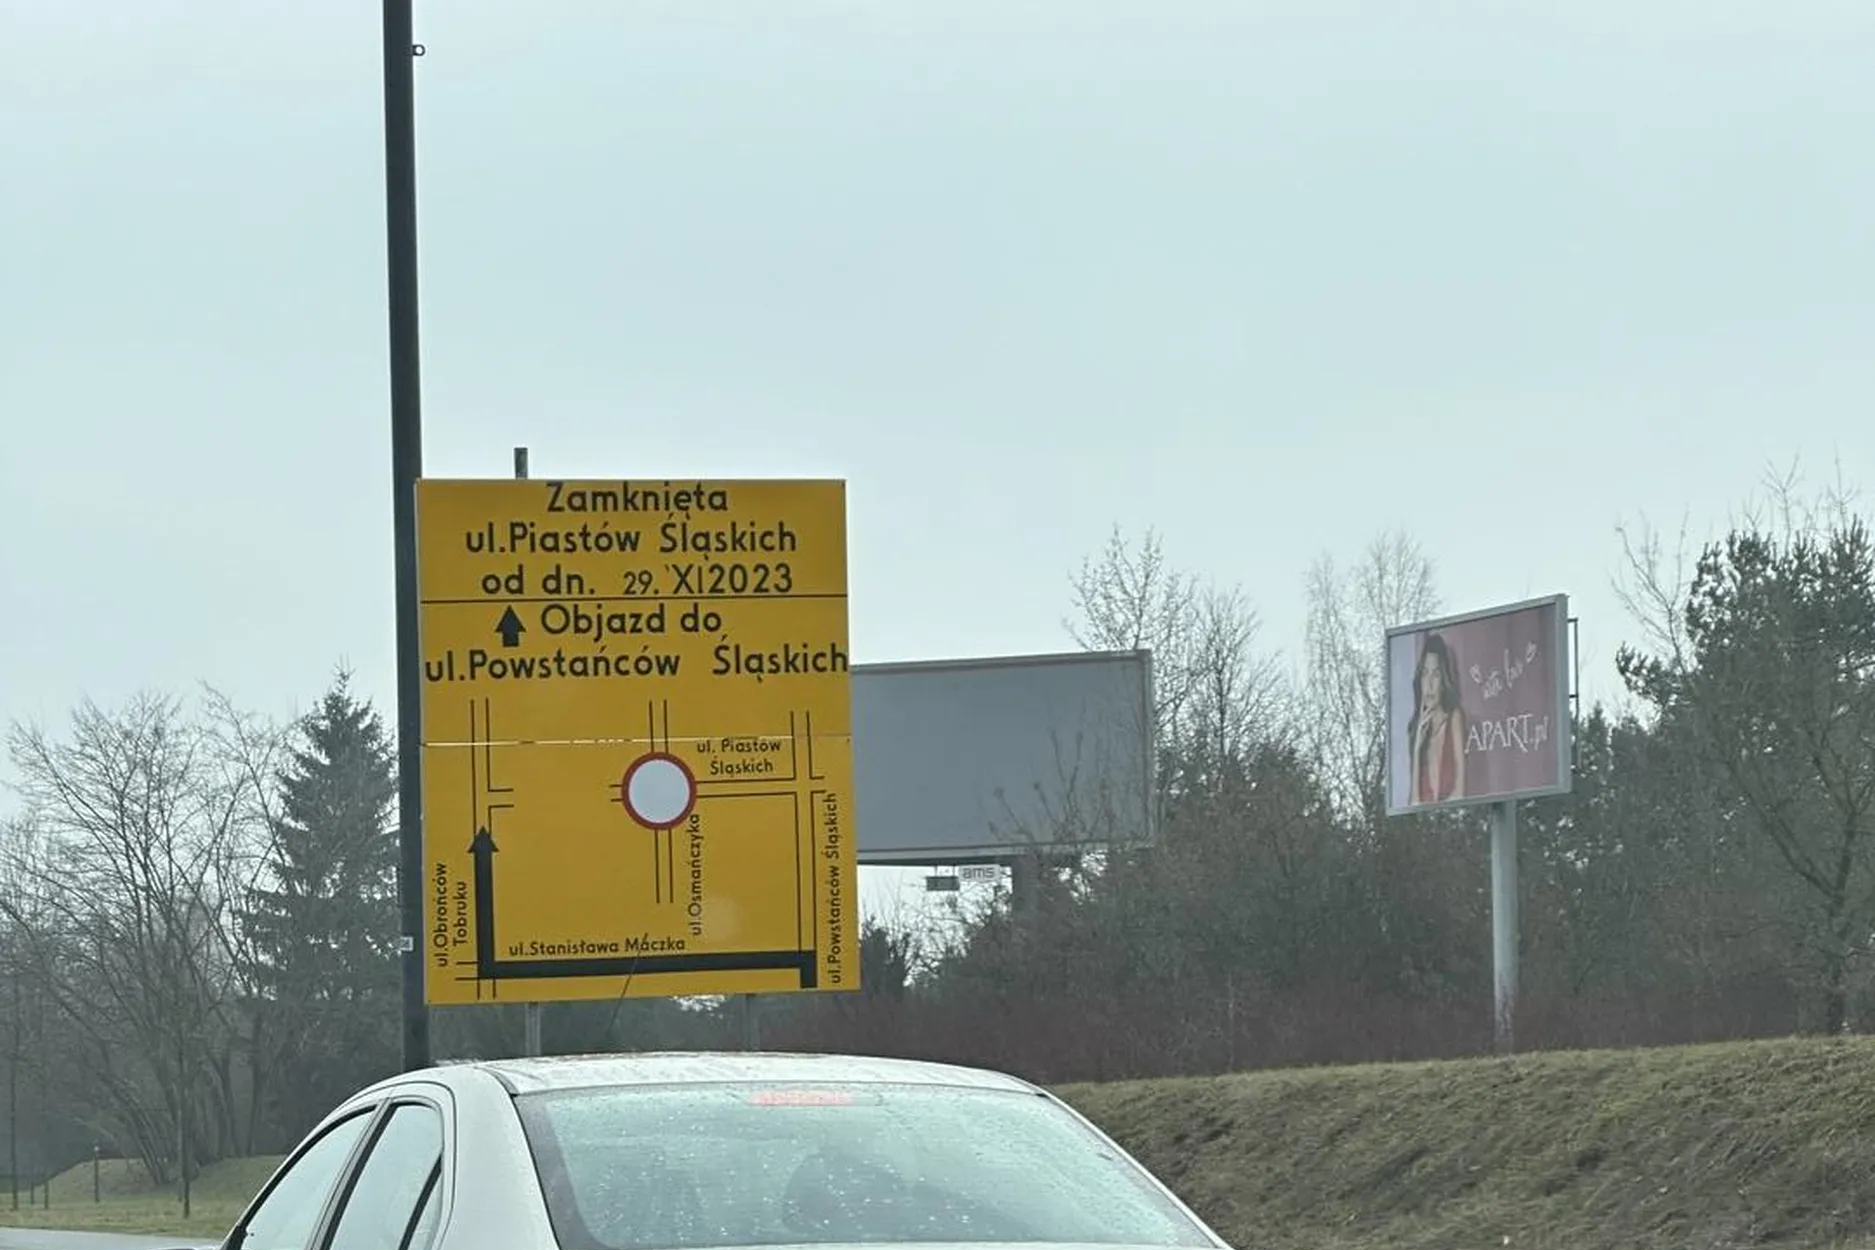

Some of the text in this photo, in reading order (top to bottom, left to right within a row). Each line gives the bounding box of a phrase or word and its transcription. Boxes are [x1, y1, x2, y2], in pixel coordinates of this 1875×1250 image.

[547, 481, 728, 519] Zamknięta
[659, 513, 797, 561] Śląskich
[481, 563, 525, 596] od
[541, 563, 596, 596] dn.
[623, 569, 661, 596] 29.
[540, 602, 722, 643] Objazd do
[711, 634, 848, 684] Śląskich
[709, 755, 774, 777] Śląskich
[821, 792, 843, 859] Śląskich
[963, 867, 995, 879] ams
[453, 881, 468, 947] Tobruku
